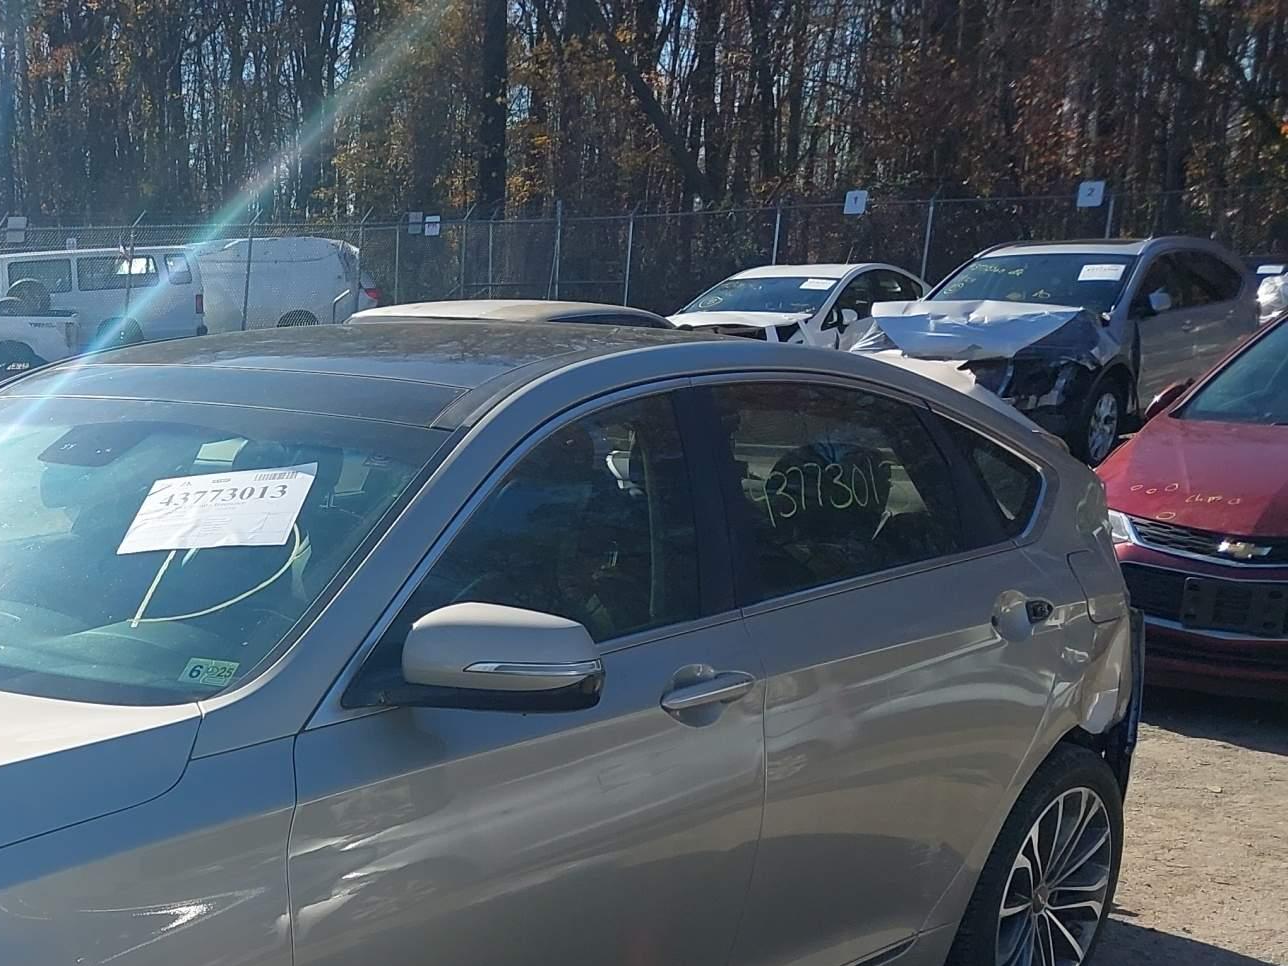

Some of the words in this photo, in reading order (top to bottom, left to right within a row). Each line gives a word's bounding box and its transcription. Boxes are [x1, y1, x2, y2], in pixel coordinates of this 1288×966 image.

[1087, 187, 1096, 197] 2
[159, 484, 289, 507] 43773013
[189, 665, 203, 678] 6
[217, 667, 234, 678] 25
